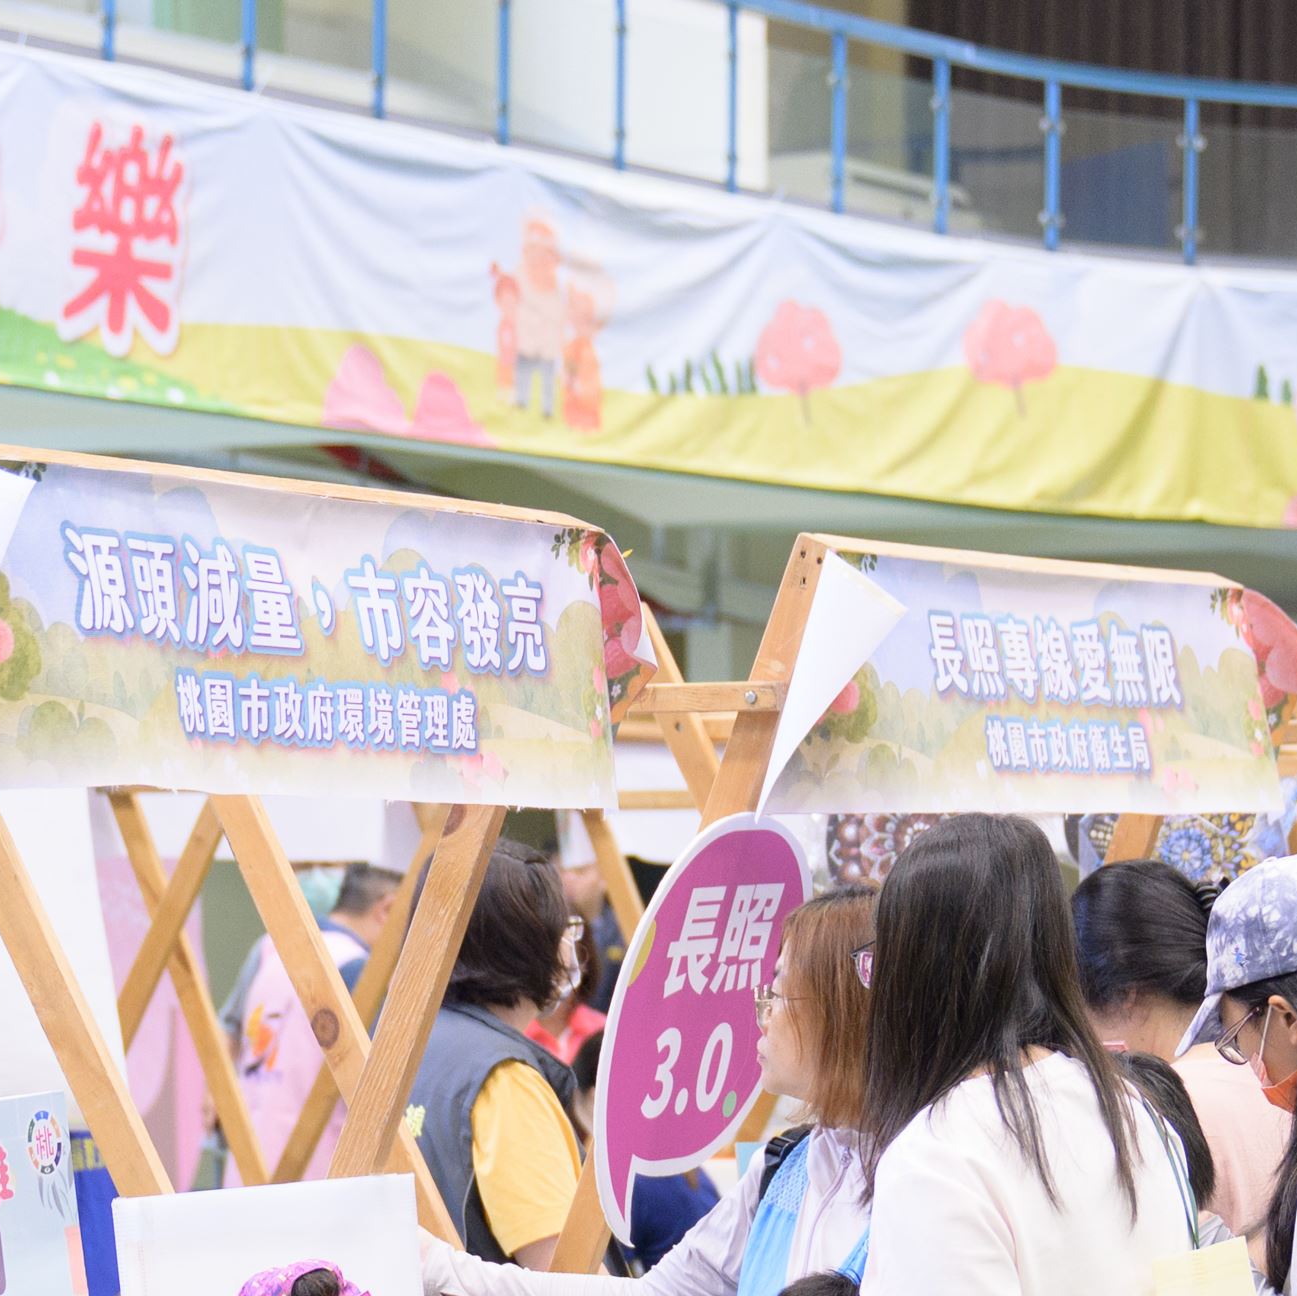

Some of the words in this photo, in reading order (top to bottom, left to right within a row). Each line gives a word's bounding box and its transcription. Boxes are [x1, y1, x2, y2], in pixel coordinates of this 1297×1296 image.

[66, 526, 549, 675] 源頭減量，市容發亮
[929, 612, 1183, 706] 長照專線愛無限
[176, 672, 479, 752] 桃園市政府環境管理處
[987, 718, 1152, 773] 桃園市政府衛生局
[663, 882, 785, 998] 長照
[640, 1022, 733, 1119] 3.0
